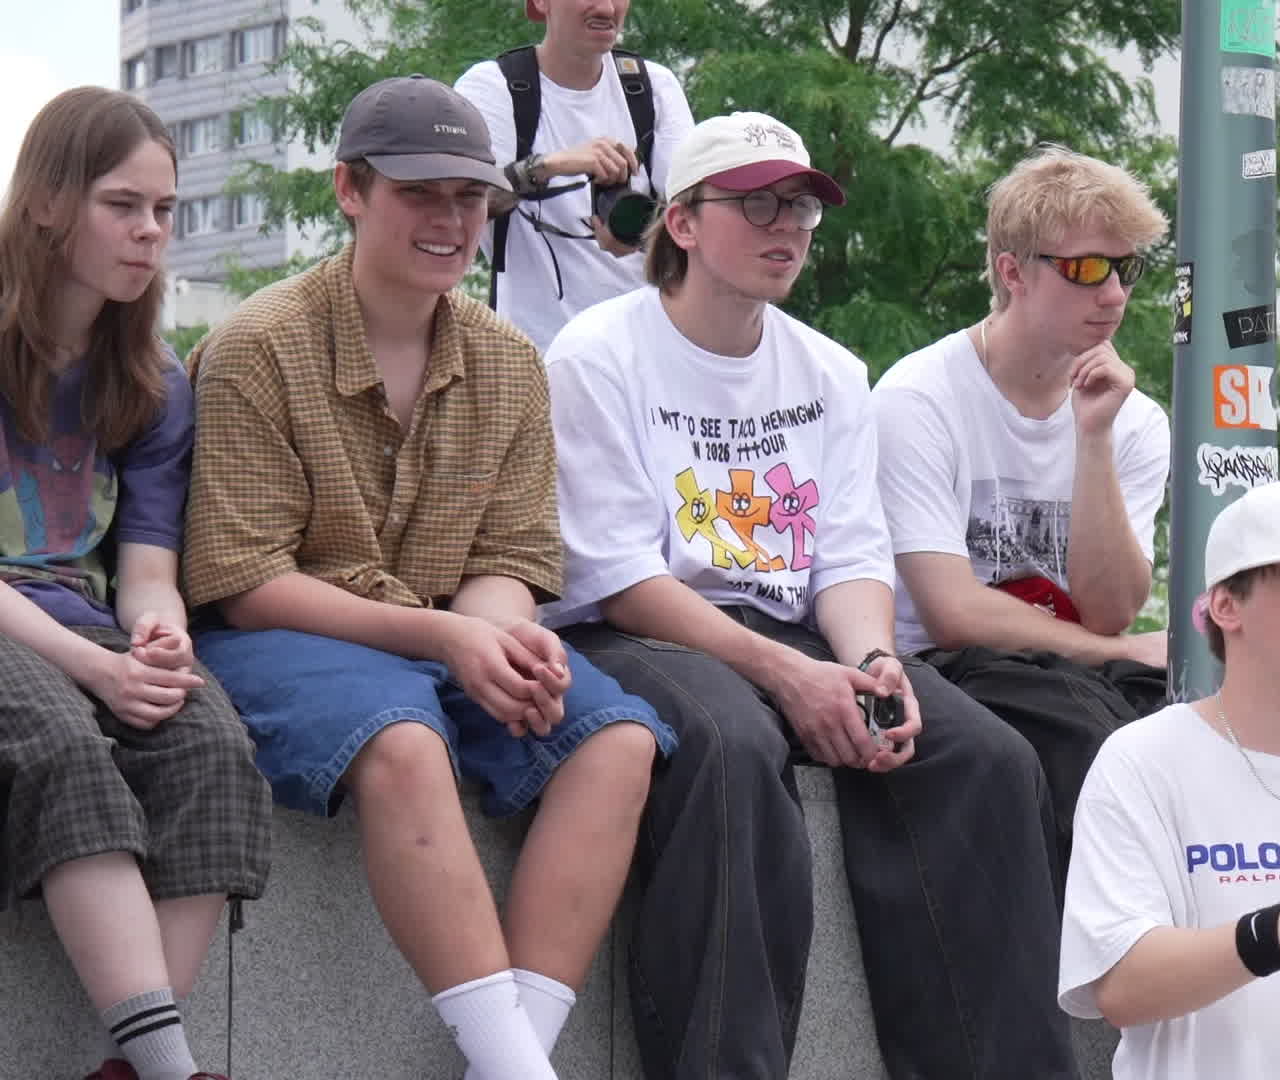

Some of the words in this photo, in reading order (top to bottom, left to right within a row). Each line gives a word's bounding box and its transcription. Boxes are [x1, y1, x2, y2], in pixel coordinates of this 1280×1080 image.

[683, 415, 696, 436] O
[700, 417, 721, 438] SEE
[728, 418, 756, 438] TACO
[761, 397, 825, 433] HEMINGWA
[705, 441, 730, 462] 2026
[756, 582, 784, 602] WAS
